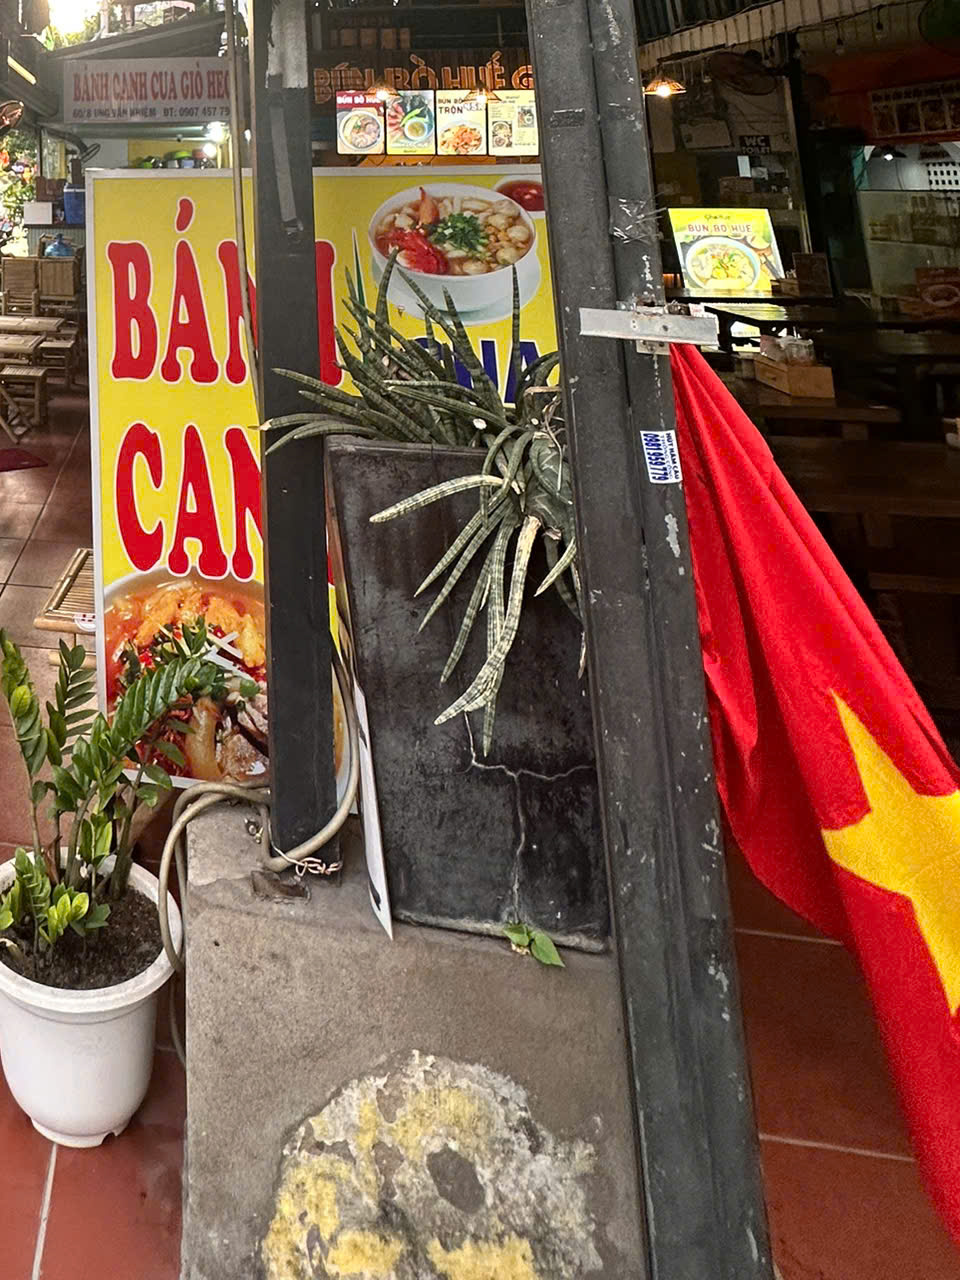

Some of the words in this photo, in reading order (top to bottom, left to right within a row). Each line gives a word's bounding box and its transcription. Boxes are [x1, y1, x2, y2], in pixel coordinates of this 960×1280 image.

[72, 64, 109, 102] BÁNH
[113, 71, 148, 102] CANH
[150, 70, 178, 101] CUA
[180, 61, 204, 100] GIÒ
[115, 422, 268, 582] CAN
